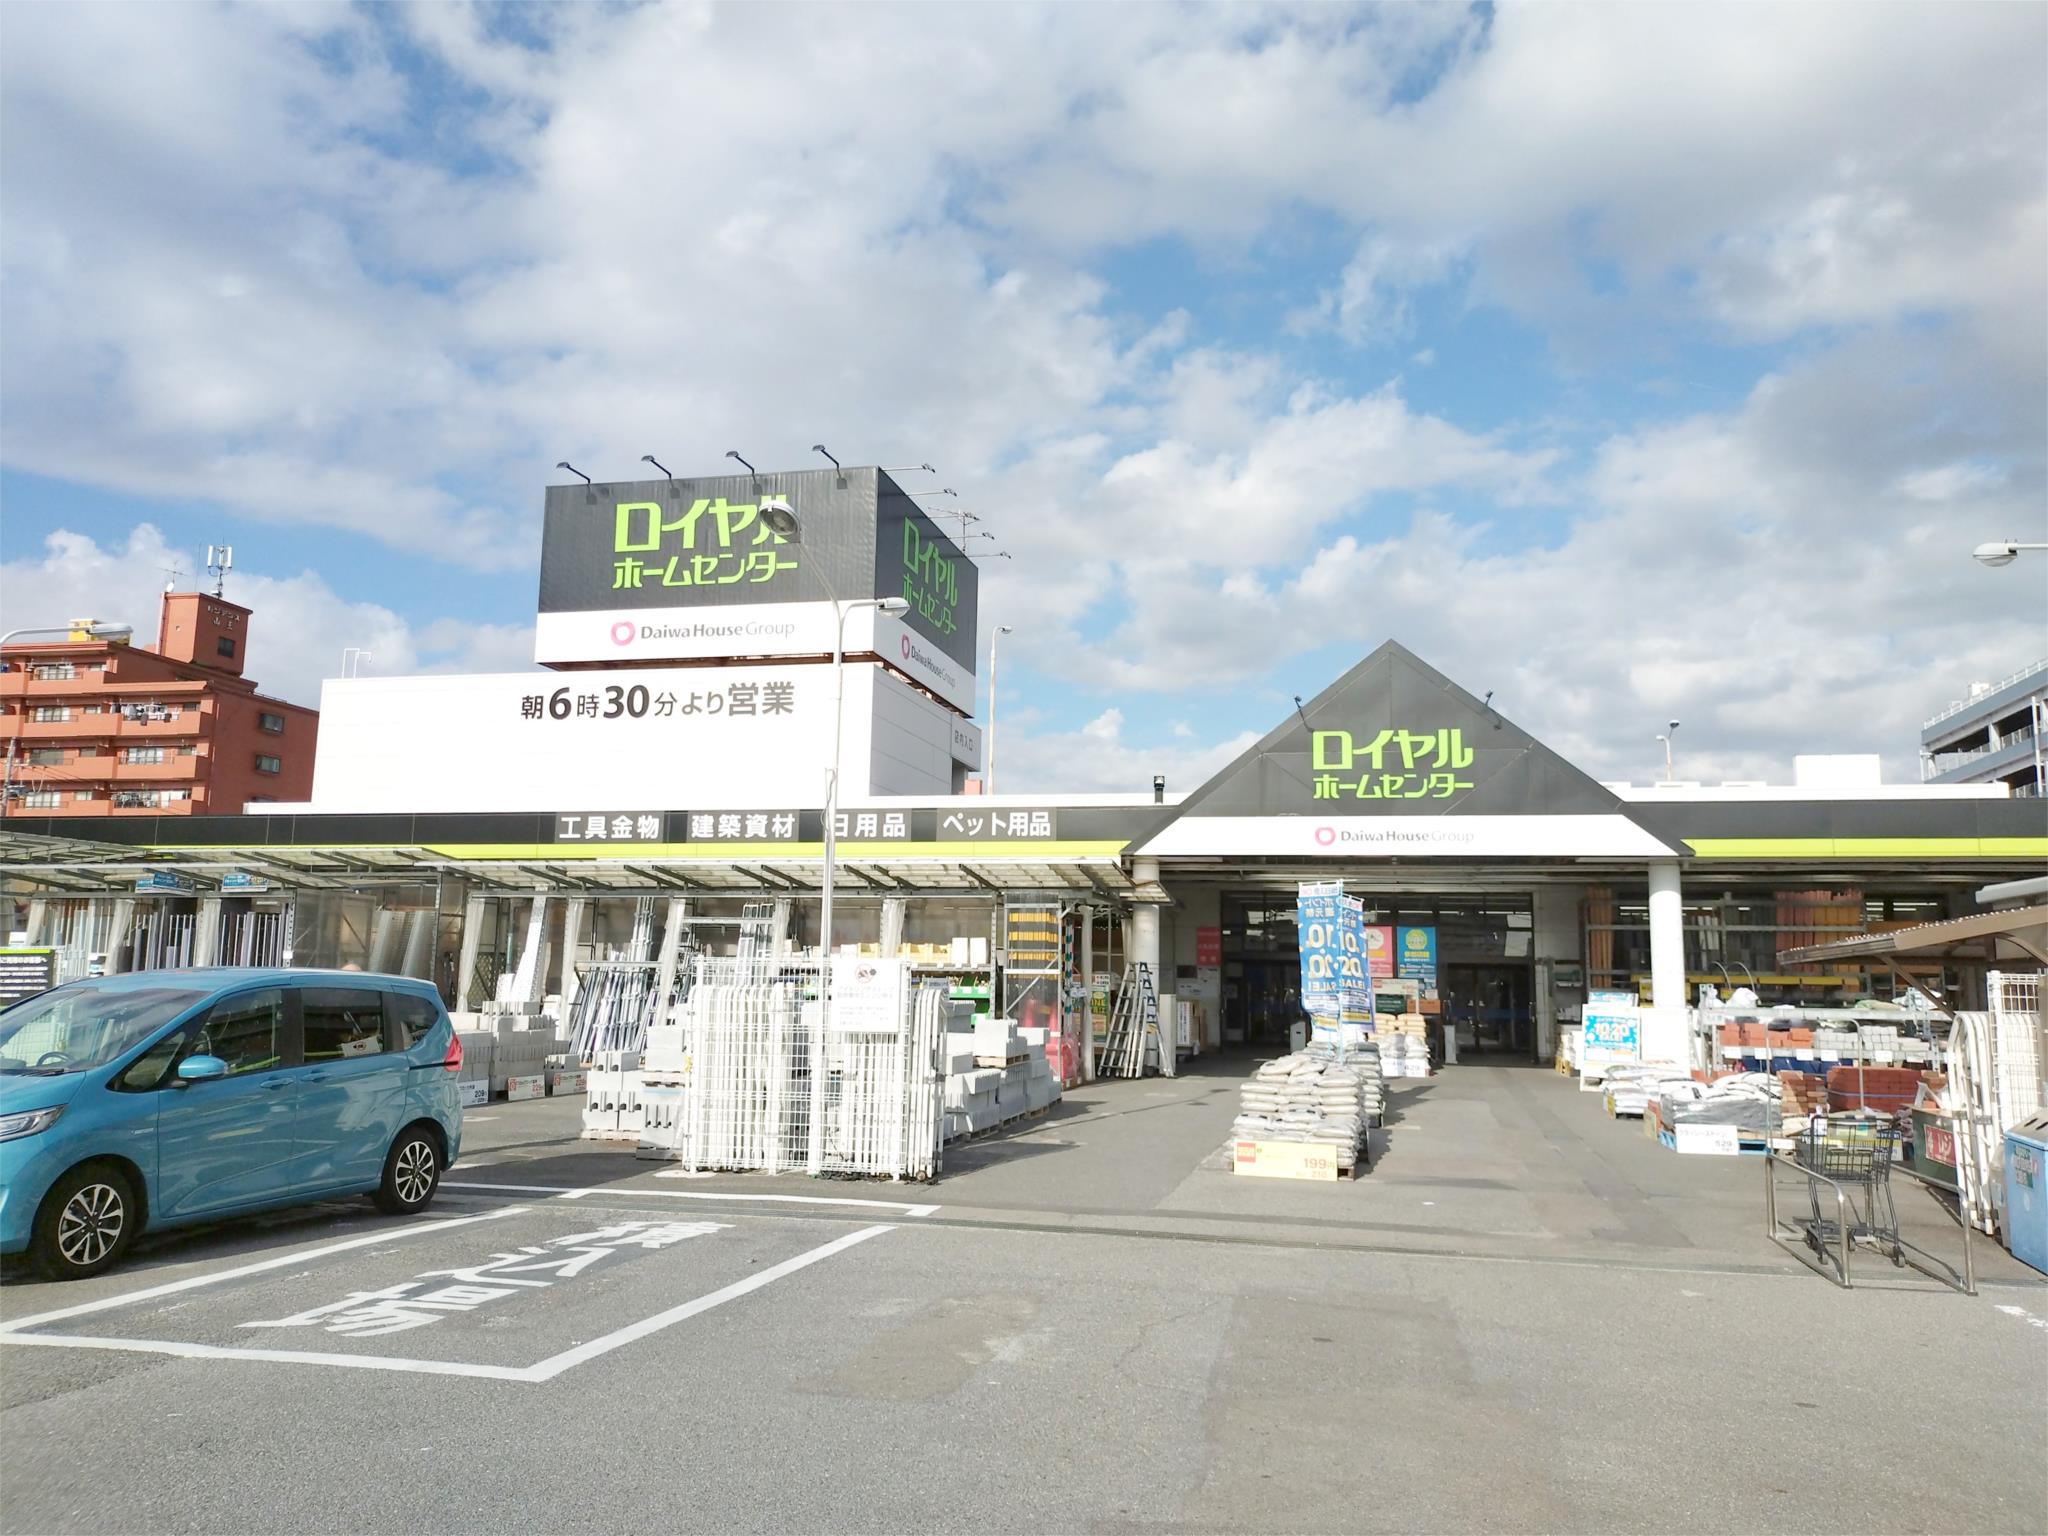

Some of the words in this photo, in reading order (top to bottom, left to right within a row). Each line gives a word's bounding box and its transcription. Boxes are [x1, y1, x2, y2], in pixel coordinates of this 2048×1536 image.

[612, 551, 799, 590] ホームセンター
[903, 515, 958, 608] ロイヤル
[640, 625, 690, 640] Daiwa
[693, 623, 743, 638] House
[745, 622, 796, 639] Group
[520, 681, 795, 722] 朝6時30分より営業
[1312, 728, 1474, 770] ロイヤル
[1312, 773, 1475, 799] ホームセンター
[559, 815, 660, 839] 工具金物
[691, 814, 795, 838] 建築資材
[943, 811, 1051, 836] ペット用品
[1341, 830, 1383, 842] Daiwa
[1386, 830, 1430, 842] House
[1431, 830, 1475, 845] Group
